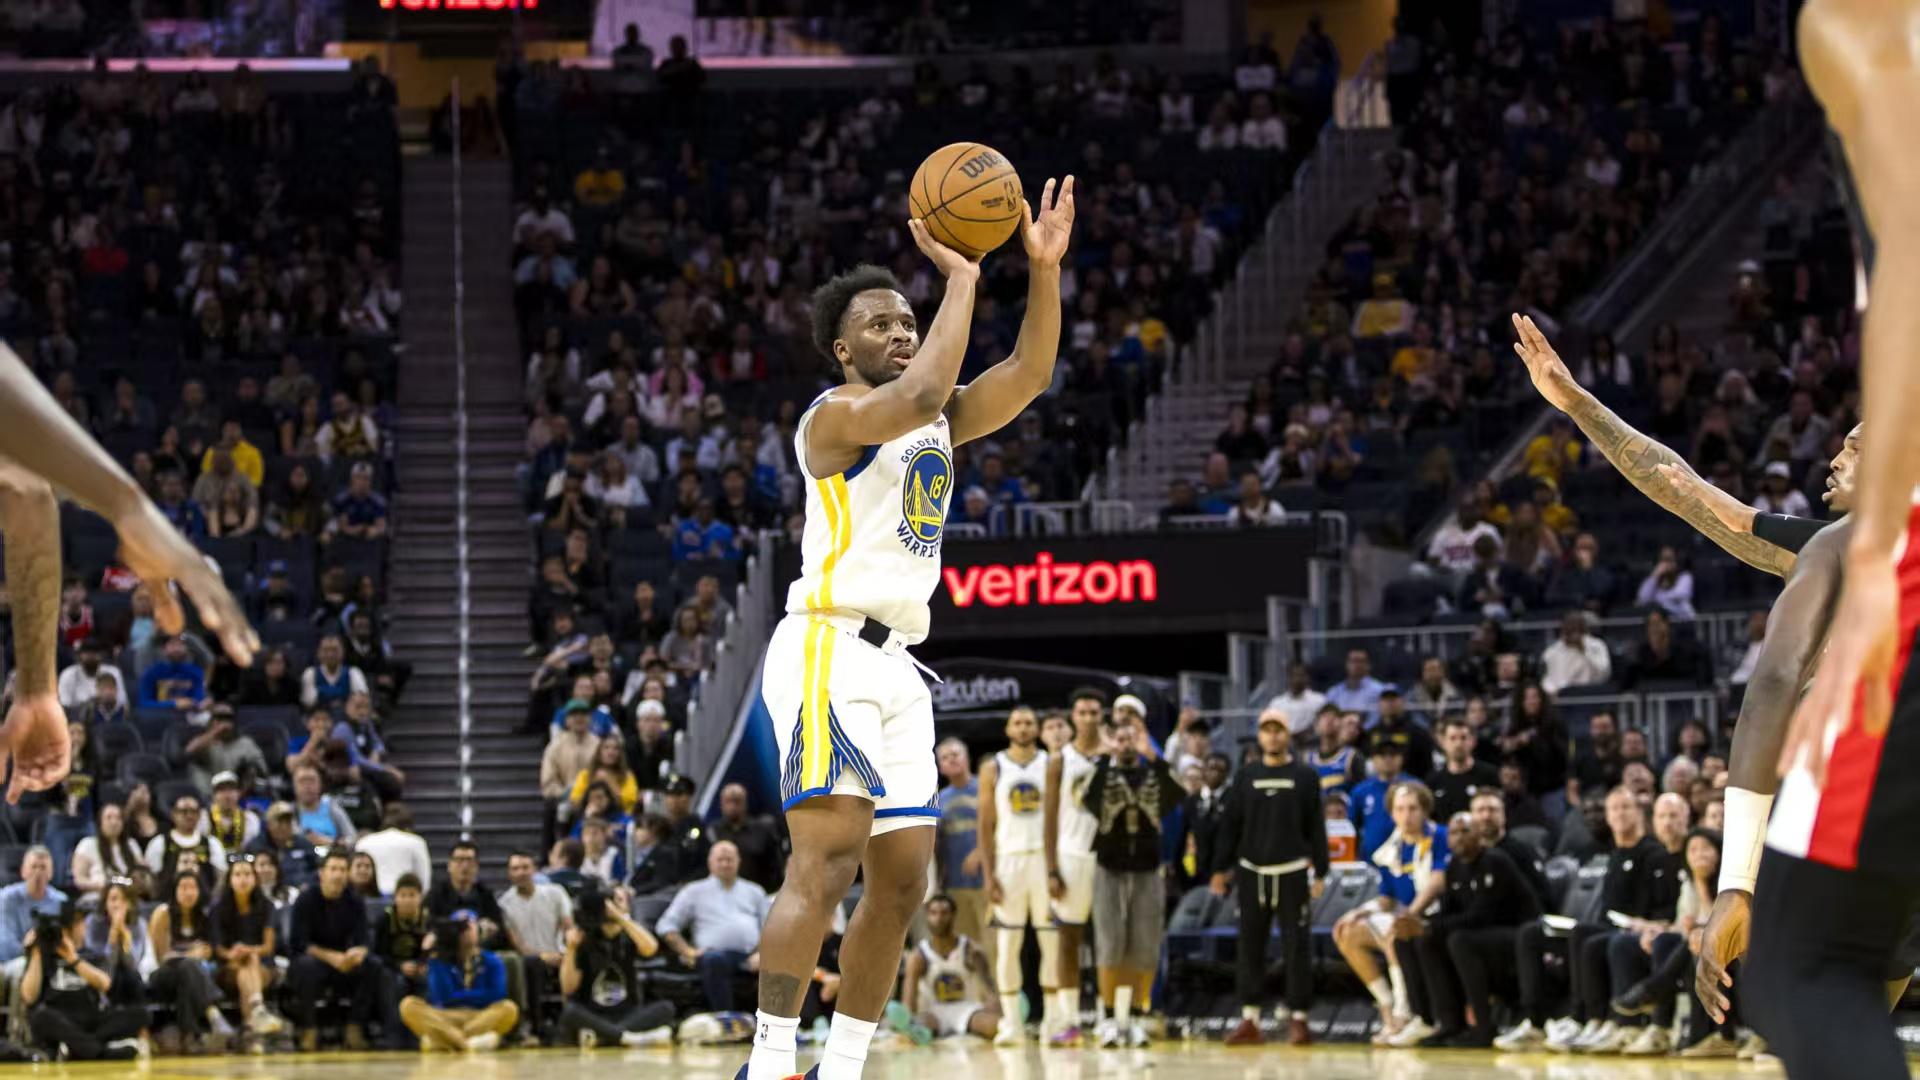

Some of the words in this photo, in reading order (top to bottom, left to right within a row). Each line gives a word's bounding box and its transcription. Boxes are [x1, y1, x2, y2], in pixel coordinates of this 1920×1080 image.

[901, 437, 939, 463] GOLDEN
[930, 474, 945, 500] 18
[943, 551, 1157, 608] verizon
[930, 676, 1021, 704] akuten
